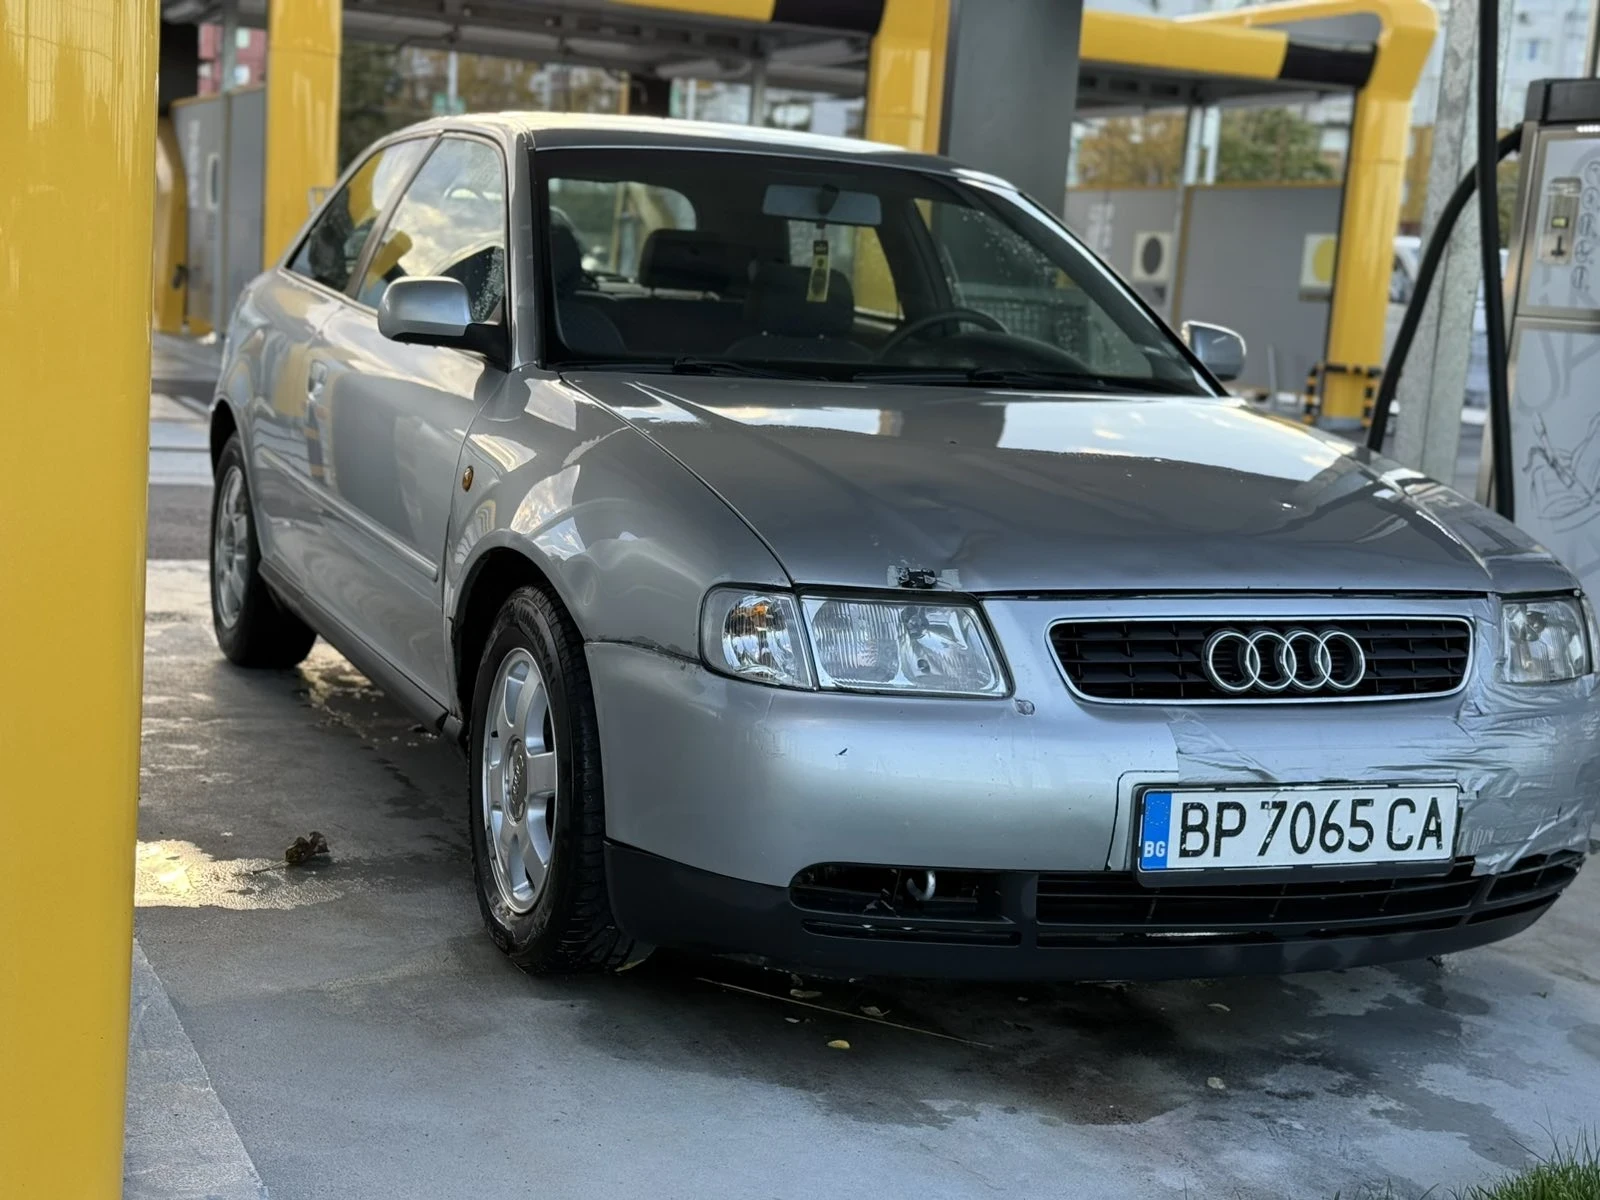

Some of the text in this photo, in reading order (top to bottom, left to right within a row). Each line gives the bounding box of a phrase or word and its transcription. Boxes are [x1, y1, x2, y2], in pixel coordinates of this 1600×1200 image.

[1178, 796, 1444, 858] BP 7065 CA
[1143, 840, 1167, 858] BG
